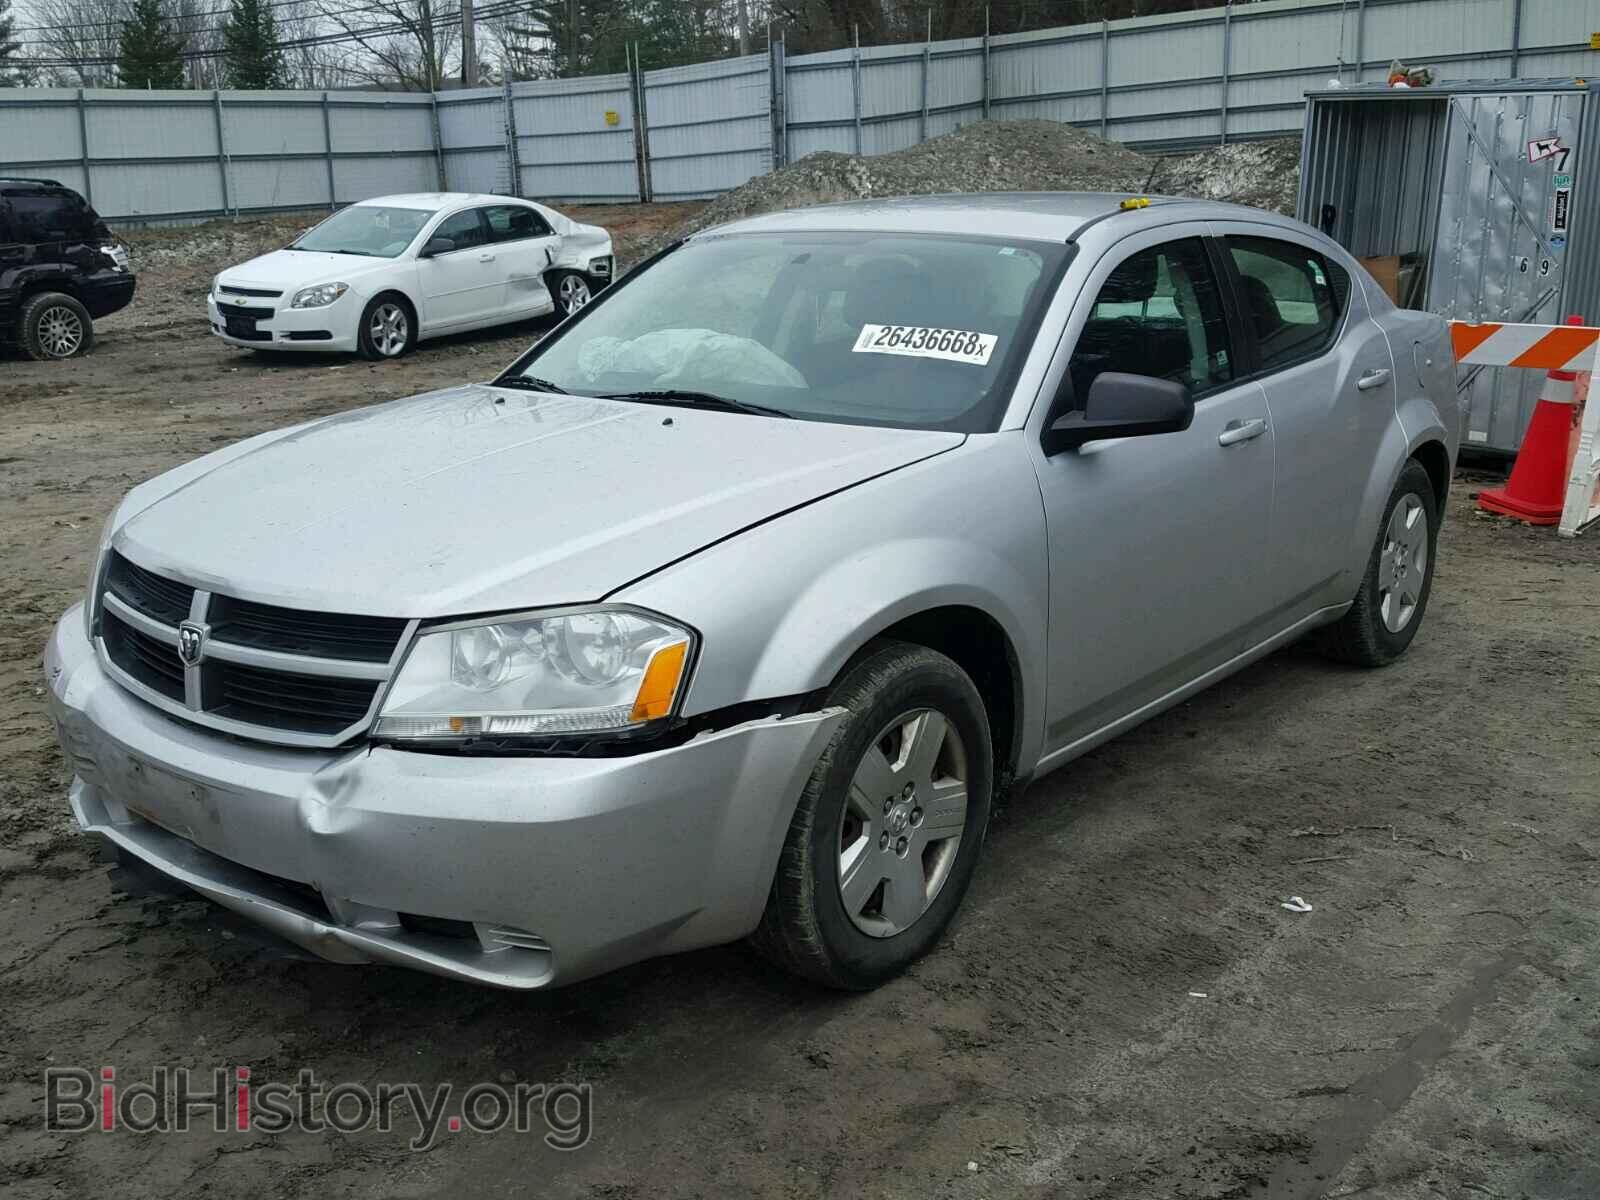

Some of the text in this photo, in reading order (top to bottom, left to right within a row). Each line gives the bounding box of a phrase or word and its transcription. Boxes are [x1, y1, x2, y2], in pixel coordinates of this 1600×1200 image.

[1558, 148, 1570, 171] 7
[1520, 257, 1549, 275] 6 9
